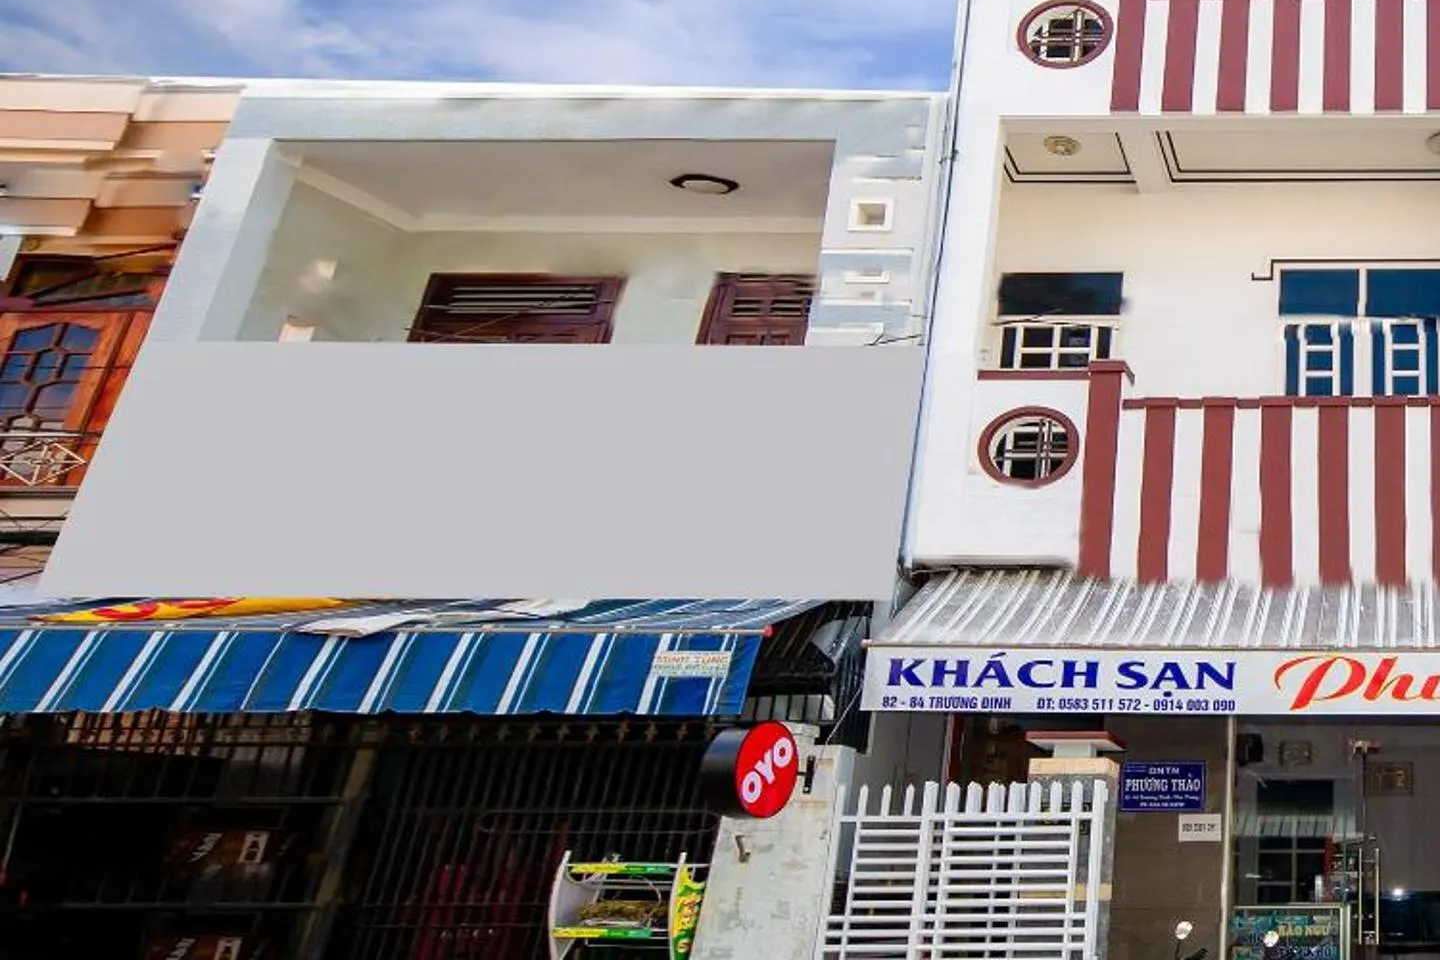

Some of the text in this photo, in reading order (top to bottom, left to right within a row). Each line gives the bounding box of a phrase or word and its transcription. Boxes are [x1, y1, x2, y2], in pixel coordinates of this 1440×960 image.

[886, 651, 1237, 698] KHÁCH SẠN
[882, 696, 898, 709] 82
[909, 696, 925, 709] 84
[1058, 697, 1090, 711] 0583
[1091, 698, 1114, 711] 511
[1117, 698, 1142, 711] 572
[1153, 698, 1184, 712] 0914
[1212, 698, 1236, 712] 090
[740, 735, 794, 804] OYO
